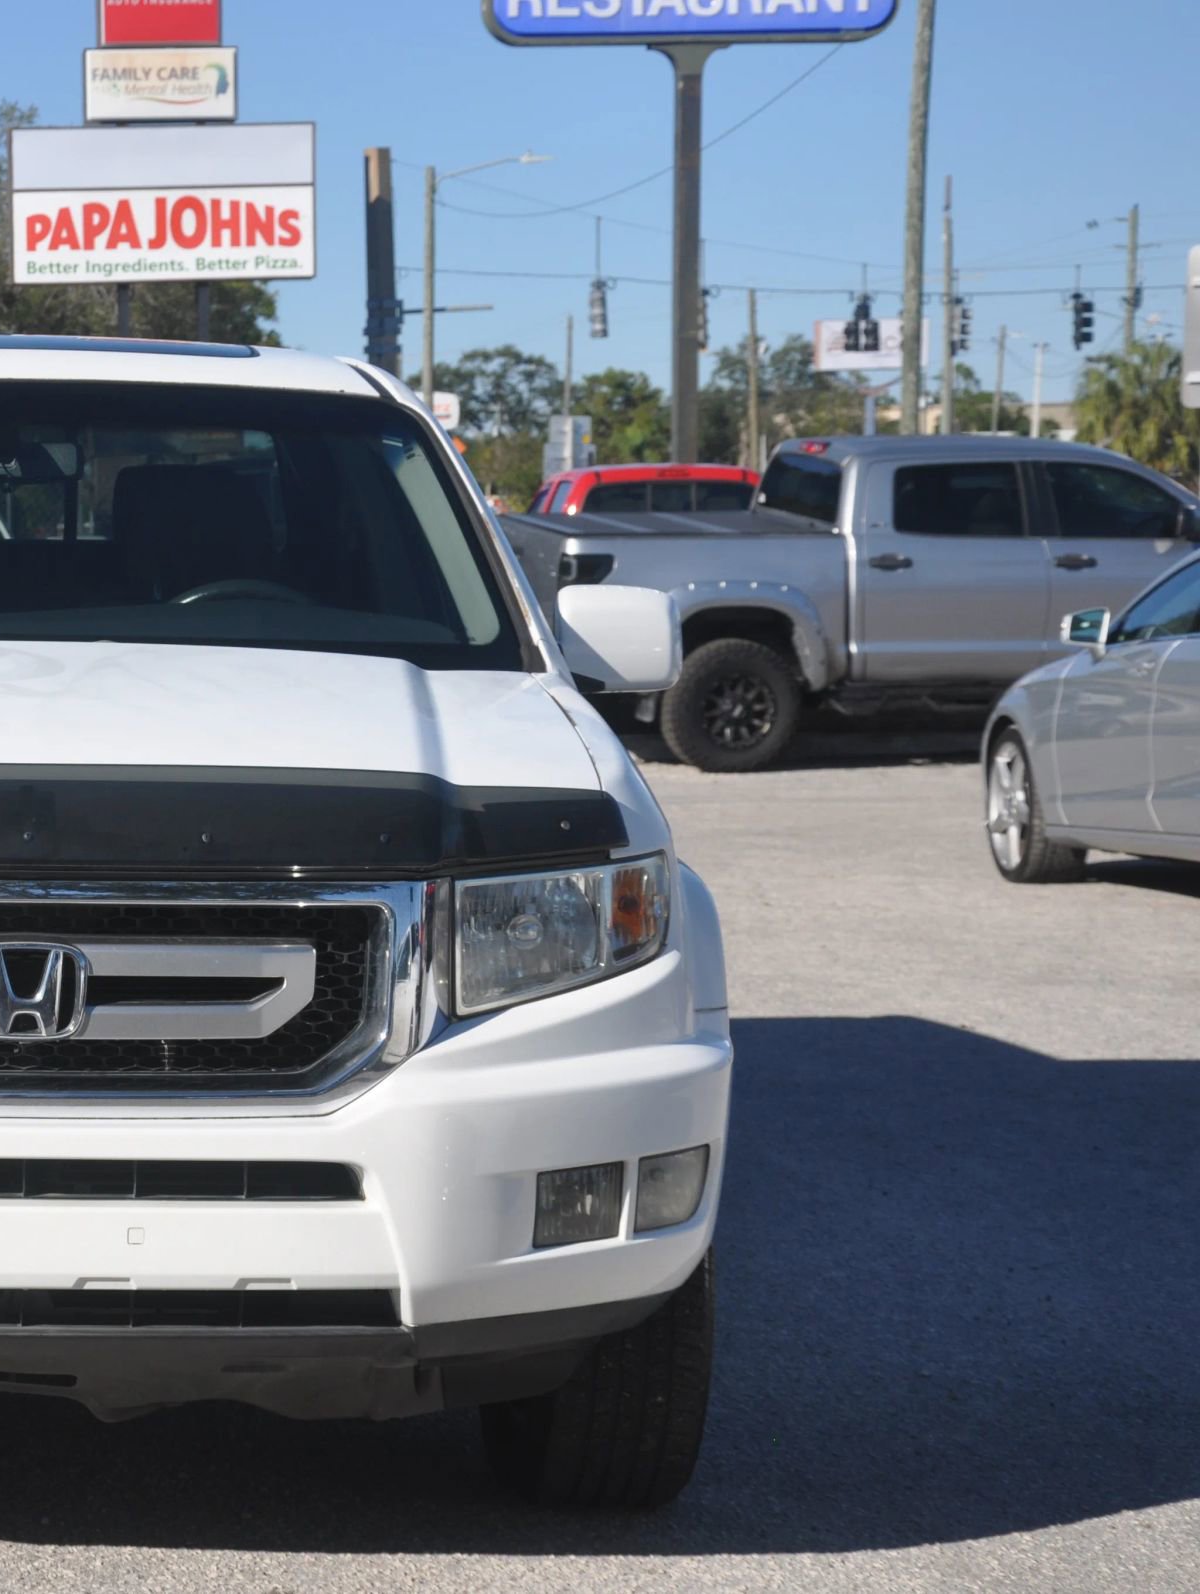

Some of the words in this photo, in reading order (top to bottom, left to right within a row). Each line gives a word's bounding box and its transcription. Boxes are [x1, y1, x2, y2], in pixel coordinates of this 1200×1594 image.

[91, 67, 152, 82] FAMILY
[156, 66, 200, 81] CARE
[123, 83, 169, 96] Mental
[26, 199, 142, 251] PAPA
[147, 195, 302, 250] JOHNS
[26, 259, 79, 275] Better
[85, 256, 189, 277] Ingredients.
[195, 256, 248, 272] Better
[254, 254, 303, 270] Pizza.
